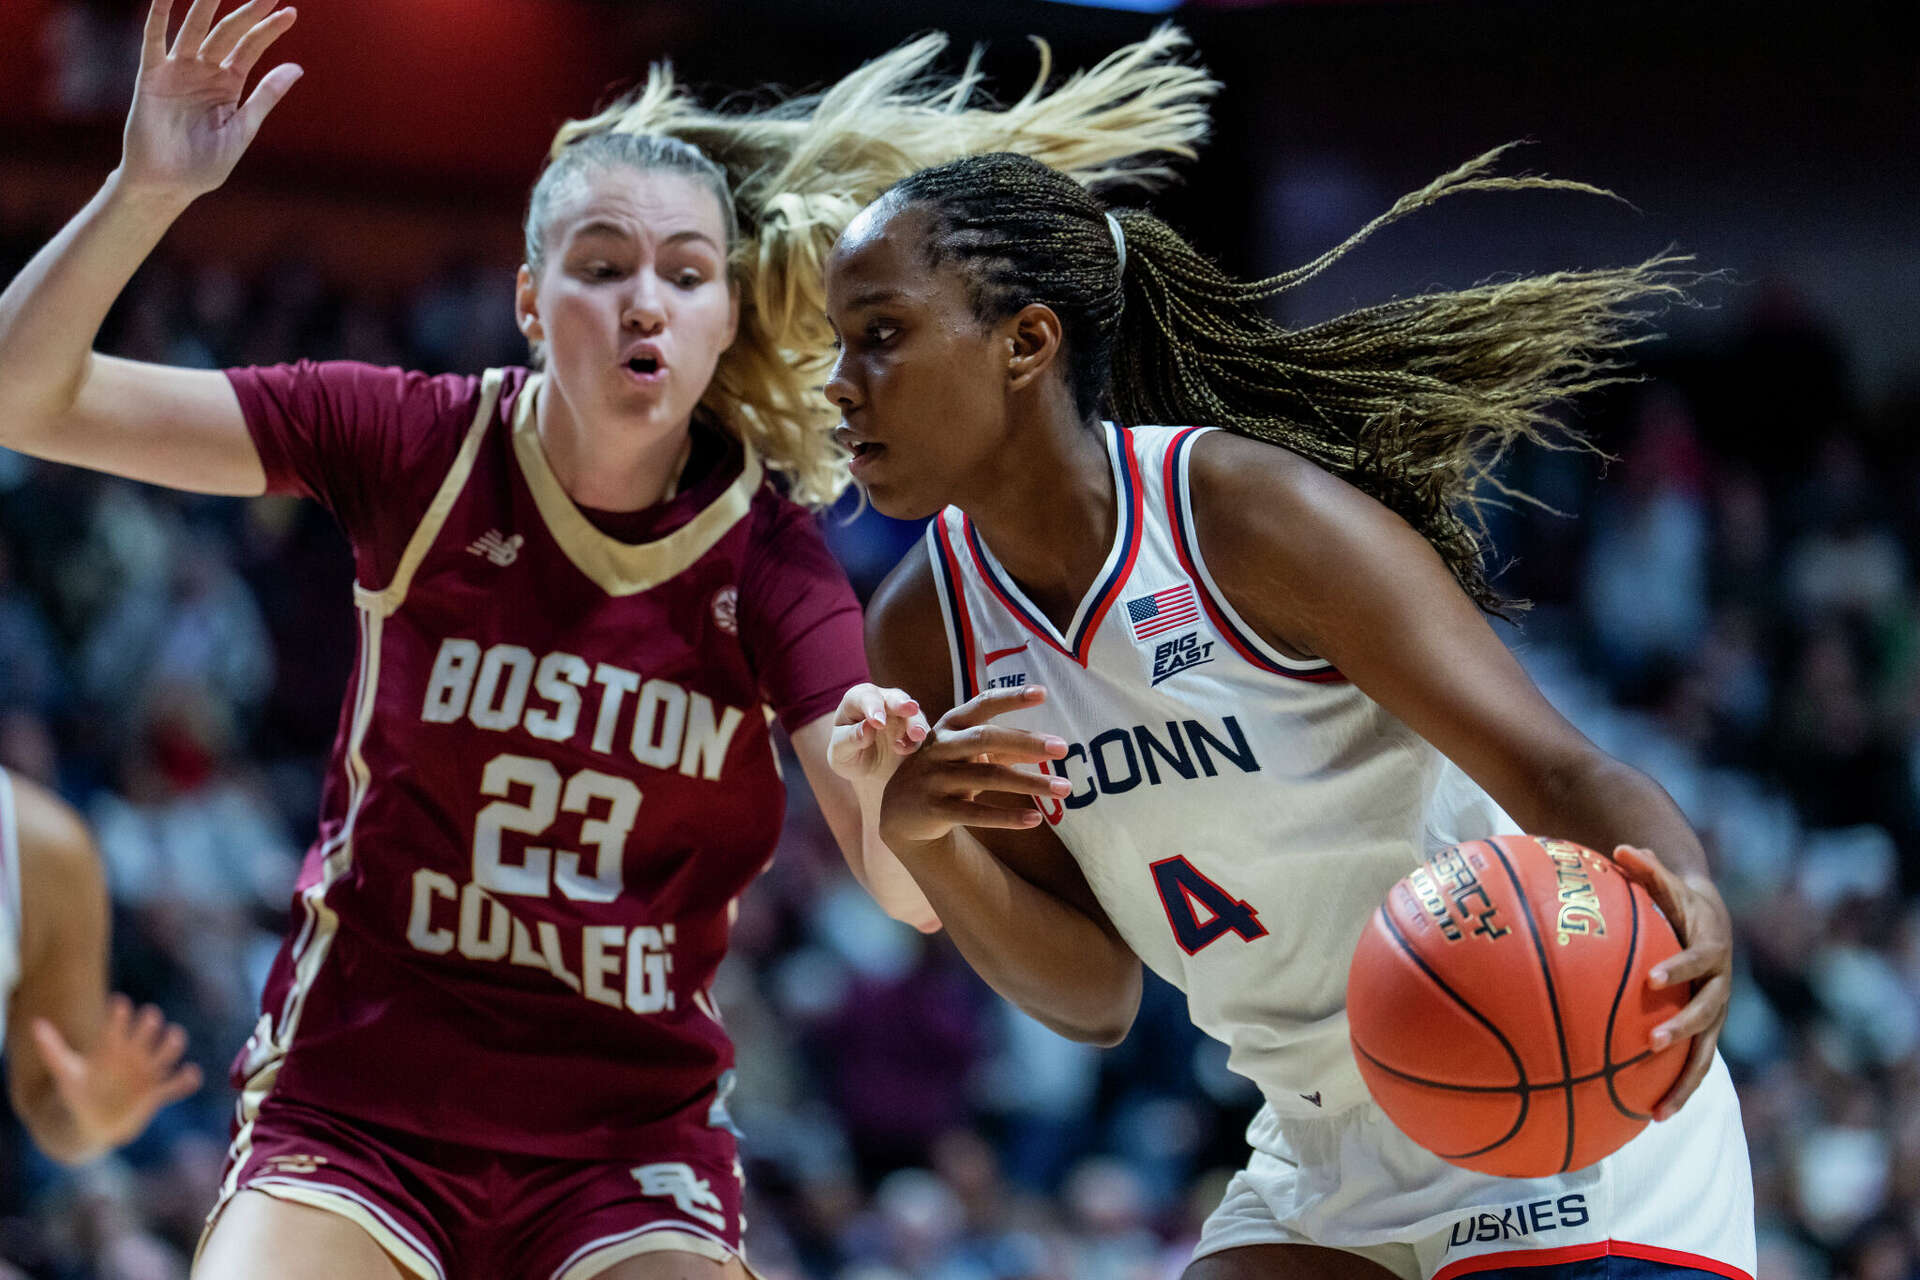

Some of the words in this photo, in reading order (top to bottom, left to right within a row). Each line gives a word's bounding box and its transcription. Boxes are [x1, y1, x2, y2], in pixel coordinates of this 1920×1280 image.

[1152, 641, 1215, 677] EAST
[1154, 631, 1198, 662] BIG
[421, 637, 744, 782] BOSTON
[998, 673, 1026, 689] THE
[472, 753, 643, 903] 23
[1149, 854, 1270, 957] 4
[1446, 1194, 1590, 1254] USKIES
